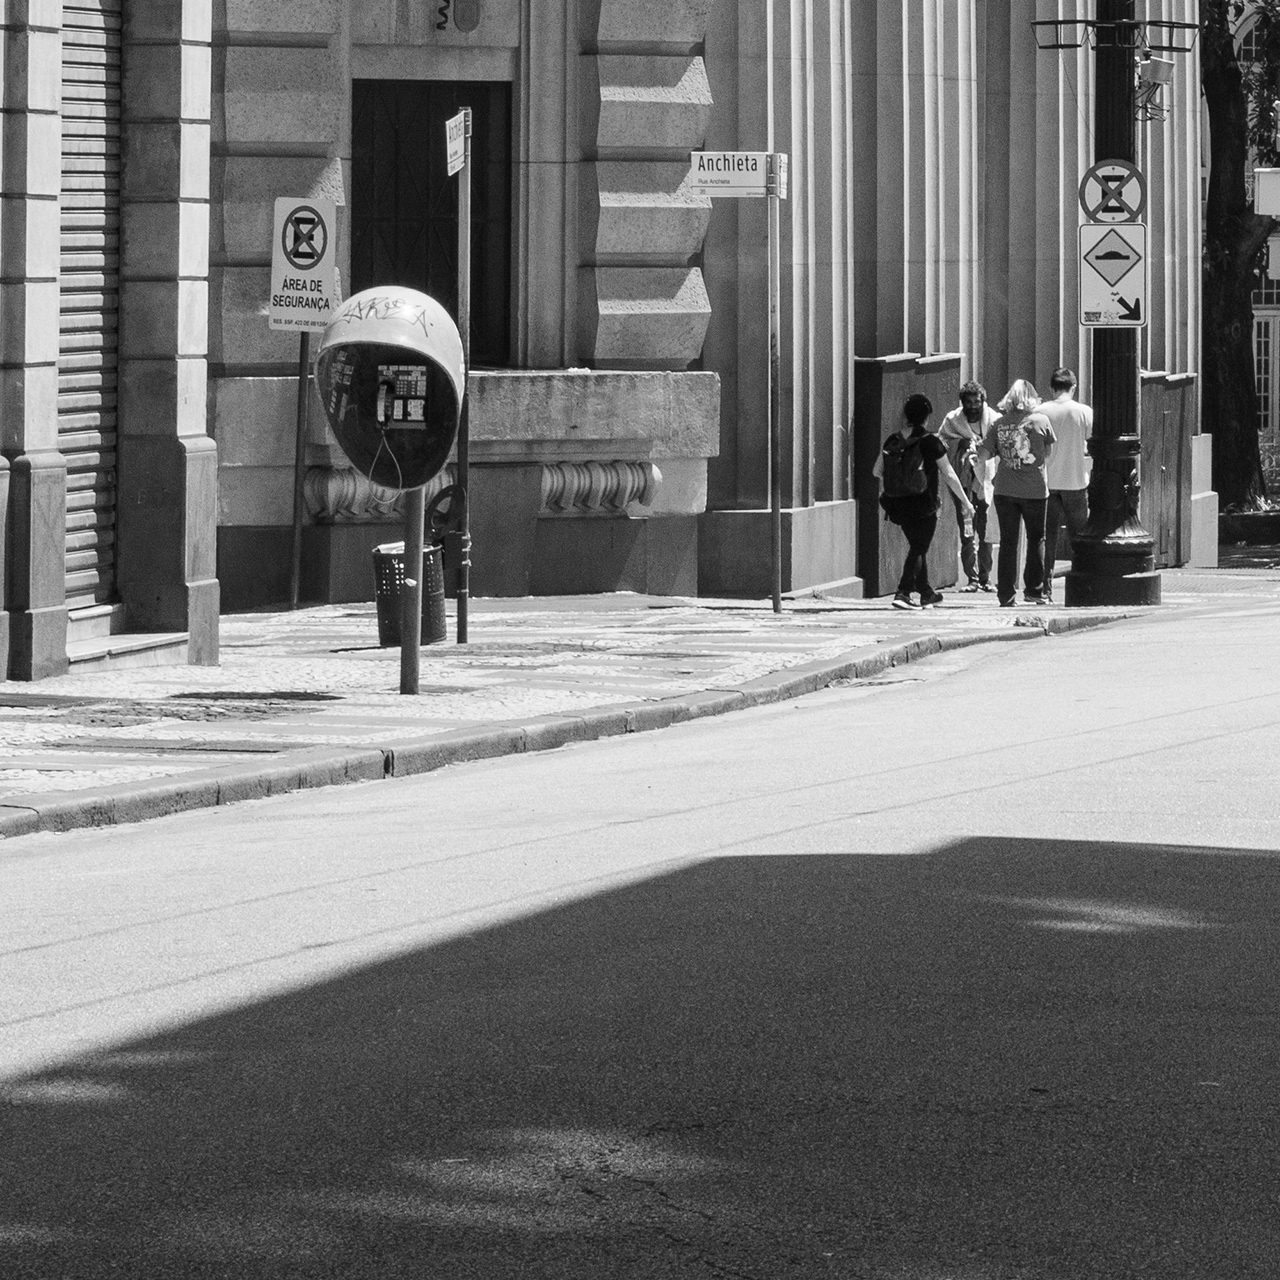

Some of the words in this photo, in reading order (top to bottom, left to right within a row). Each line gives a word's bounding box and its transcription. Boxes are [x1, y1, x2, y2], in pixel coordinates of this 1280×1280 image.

[698, 154, 758, 171] Anchieta
[282, 275, 308, 292] ÁREA
[310, 279, 323, 293] DE
[272, 294, 331, 312] SEGURANÇA
